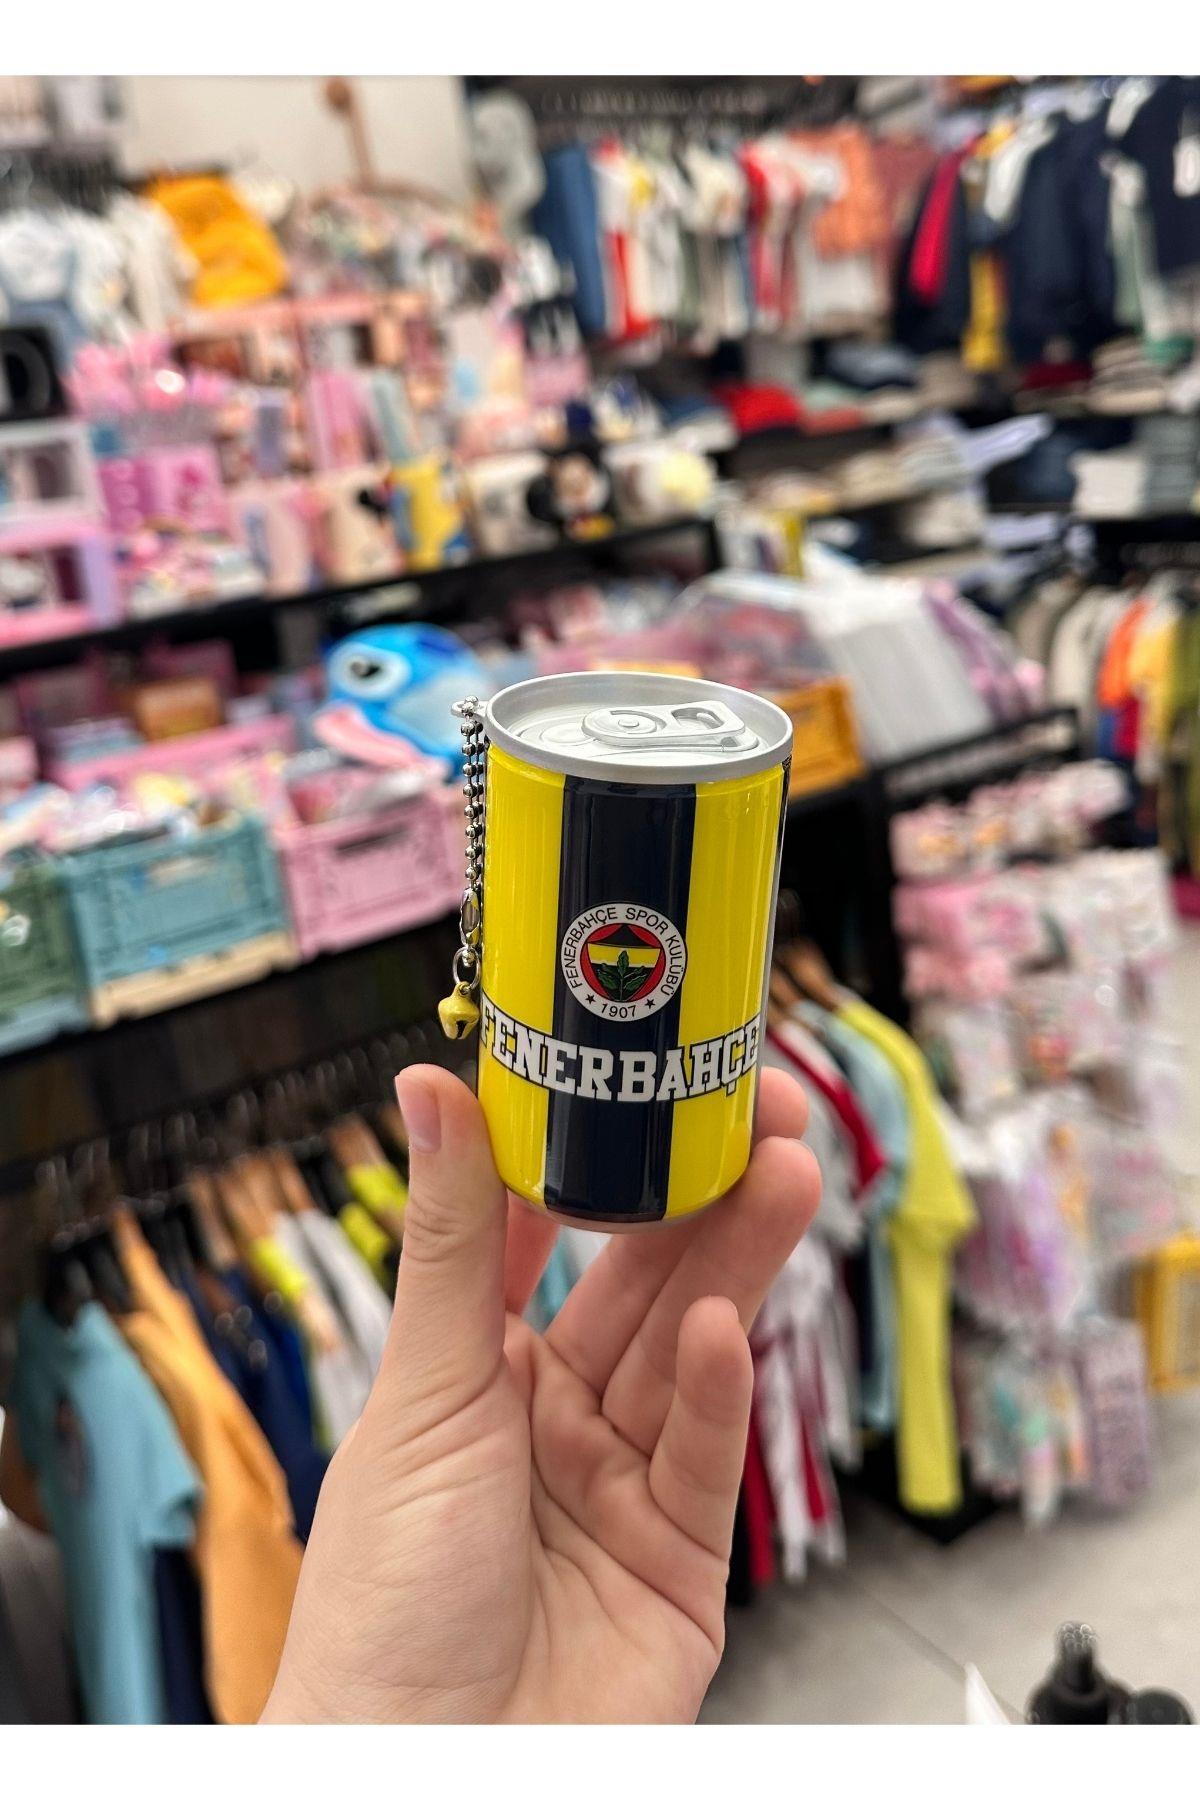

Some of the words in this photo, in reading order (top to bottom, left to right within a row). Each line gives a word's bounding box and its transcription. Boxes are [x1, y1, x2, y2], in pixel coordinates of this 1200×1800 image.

[563, 907, 619, 989] FENERBAHÇE
[625, 907, 669, 935] SPOR
[660, 935, 684, 996] KULÜBÜ
[480, 995, 761, 1103] FENERBAHÇE
[601, 1003, 637, 1018] 1907
